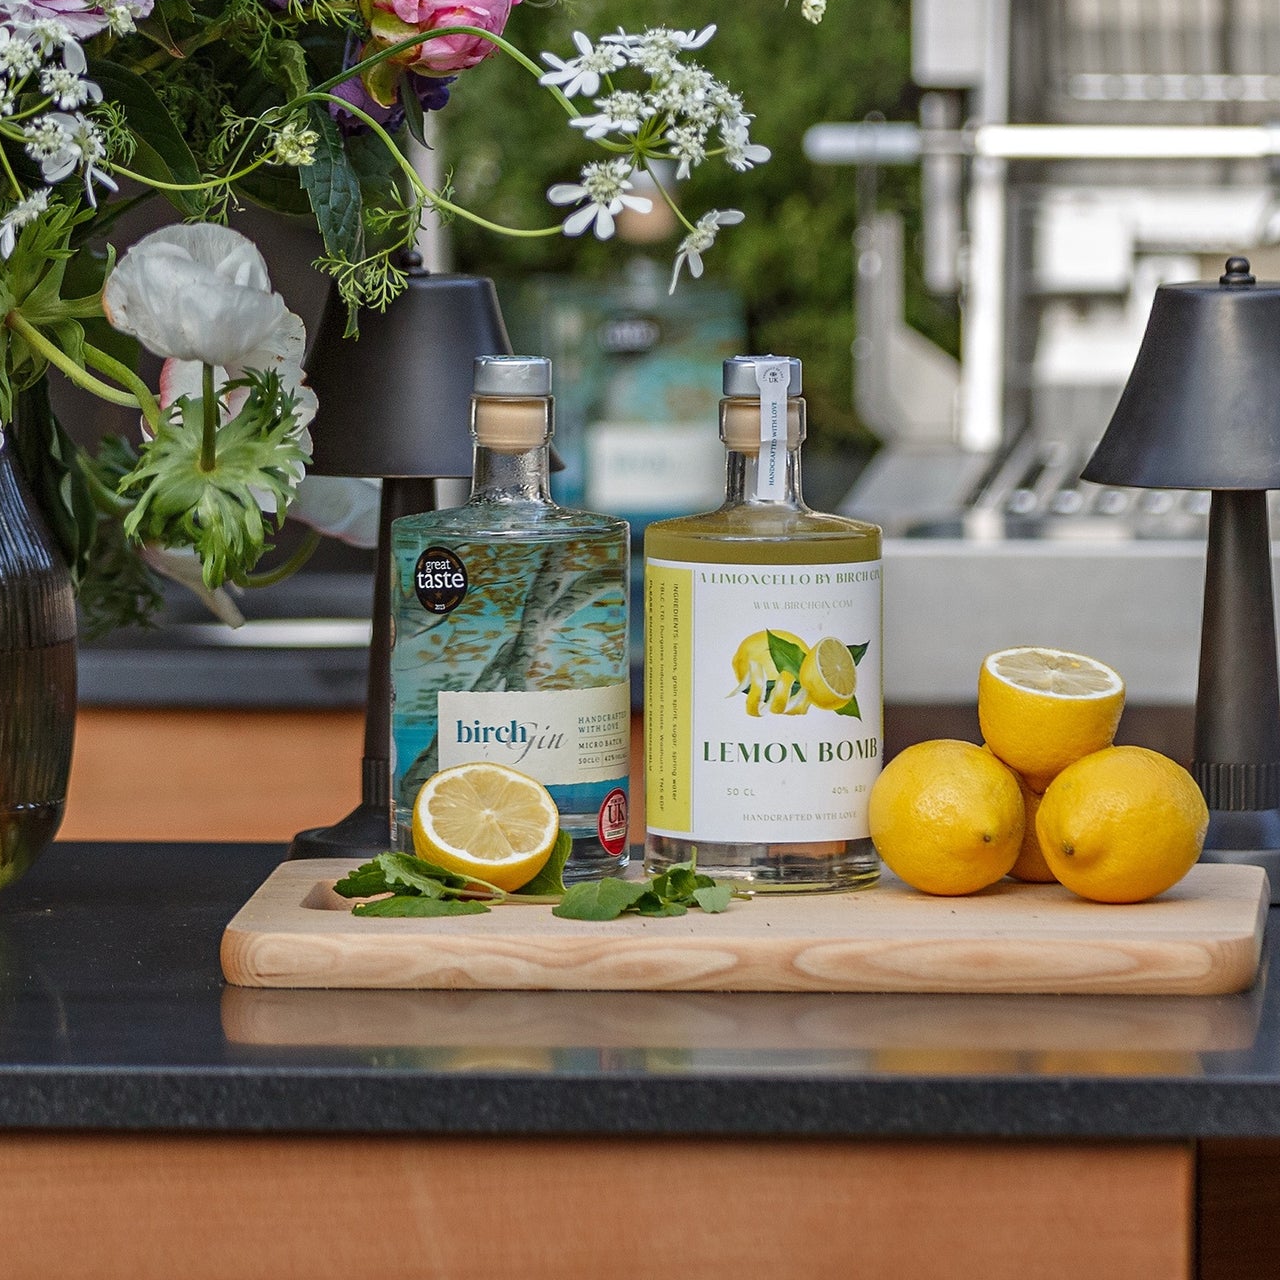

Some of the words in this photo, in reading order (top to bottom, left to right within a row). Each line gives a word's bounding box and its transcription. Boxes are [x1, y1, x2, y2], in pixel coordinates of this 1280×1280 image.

[769, 438, 777, 486] HANDCRAFTED
[426, 559, 451, 574] great
[416, 572, 464, 588] taste
[701, 572, 706, 584] A
[712, 572, 810, 585] LIMONCELLO
[816, 573, 830, 584] BY
[836, 571, 868, 584] BIRCH
[603, 722, 618, 731] LOVE
[456, 720, 527, 742] birch
[506, 722, 568, 764] Gin
[578, 740, 604, 748] MICRO
[704, 741, 808, 764] LEMON
[818, 737, 878, 762] BOMB
[726, 788, 740, 796] 50
[832, 786, 848, 794] 40%
[608, 804, 624, 824] UK
[838, 811, 857, 819] LOVE
